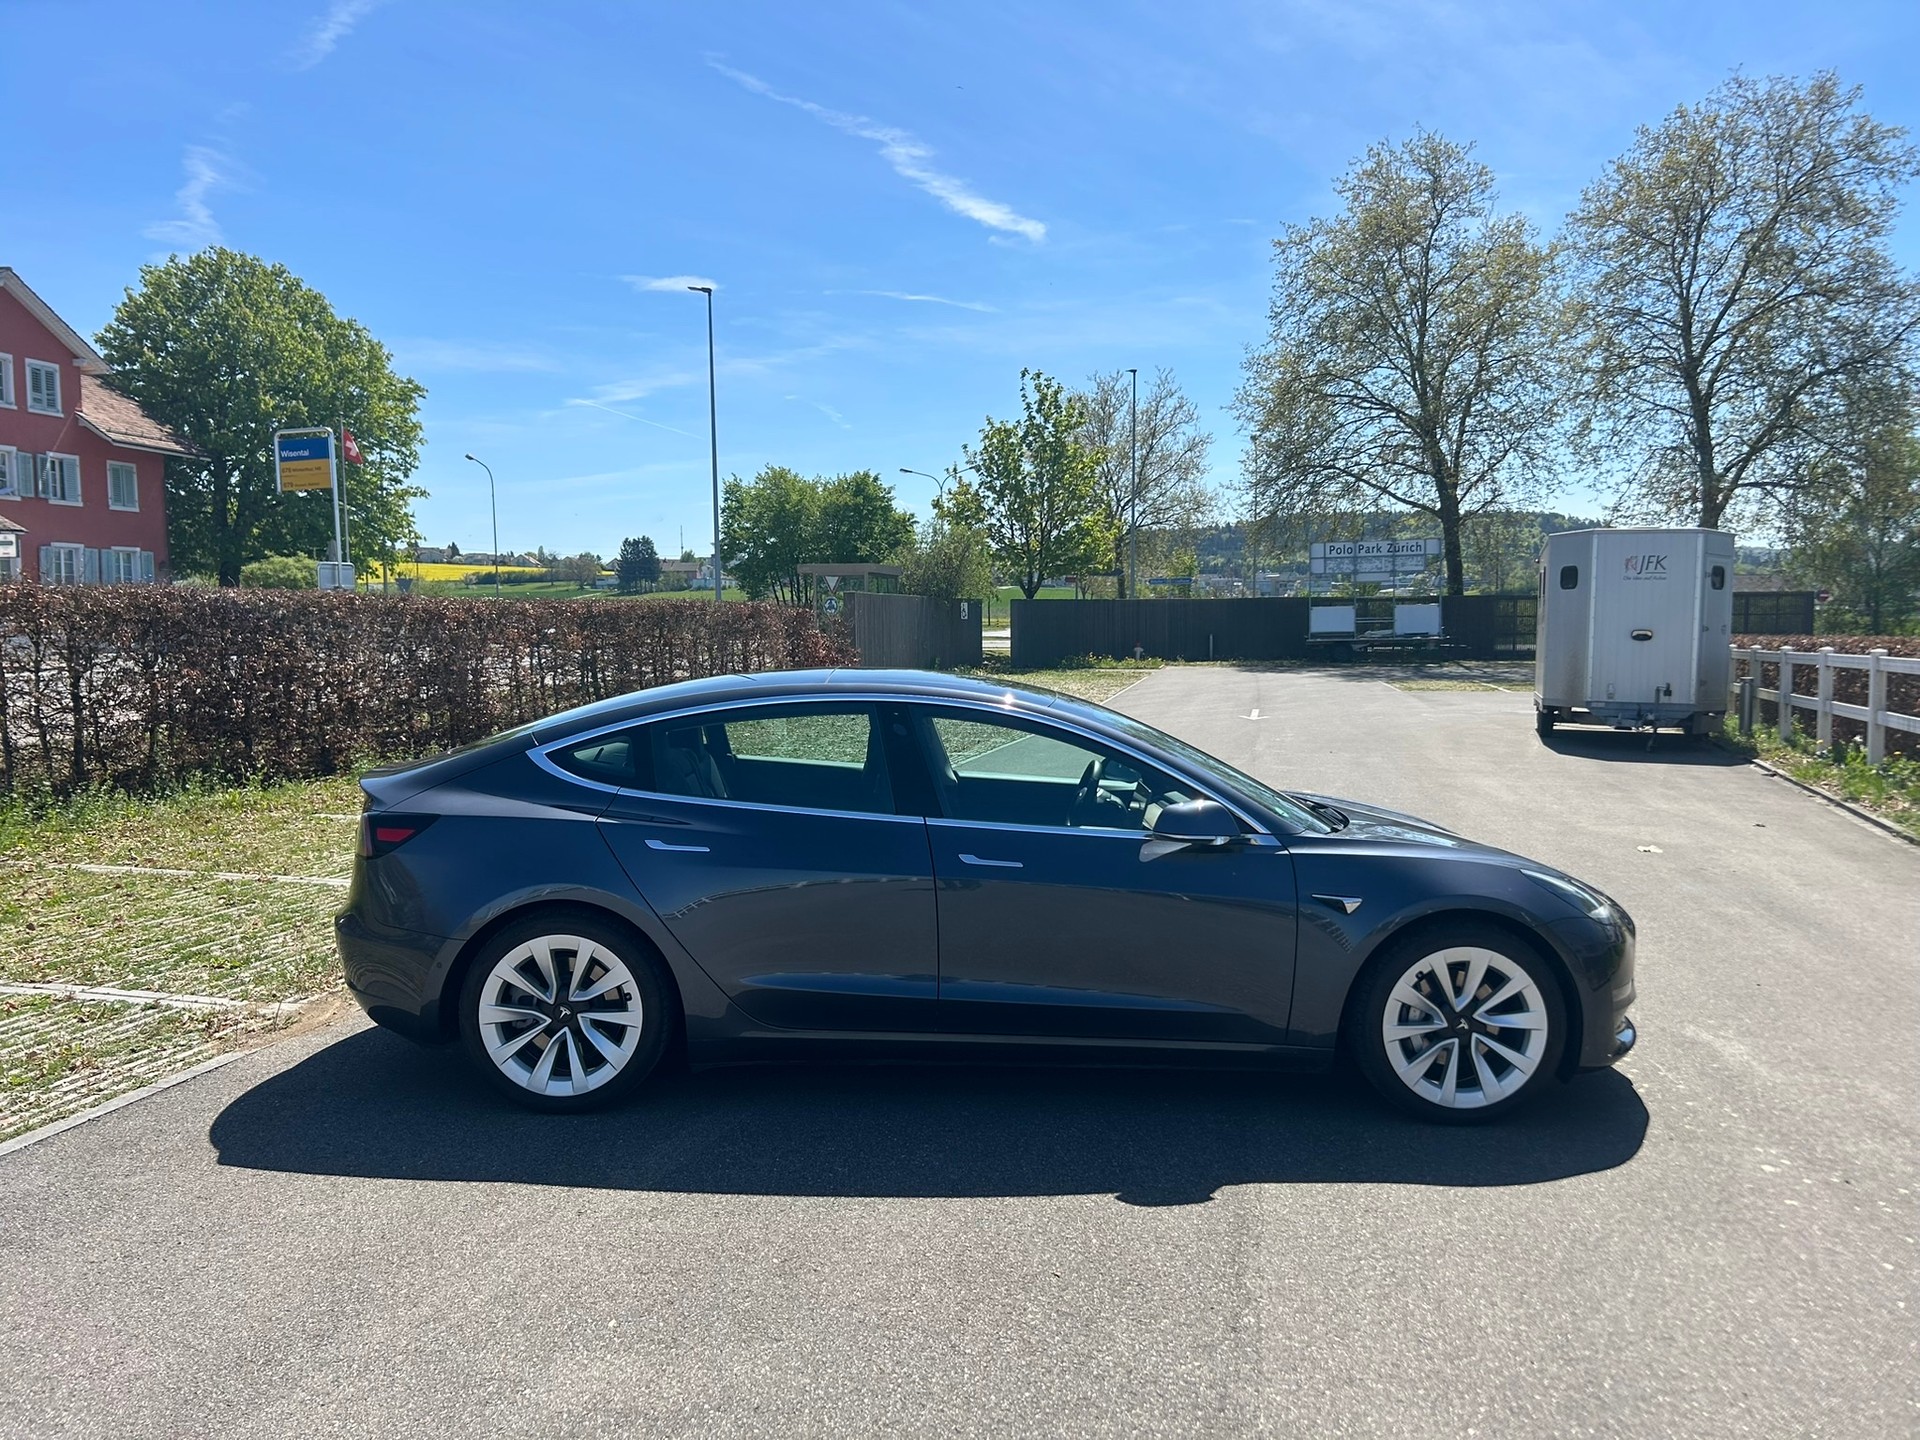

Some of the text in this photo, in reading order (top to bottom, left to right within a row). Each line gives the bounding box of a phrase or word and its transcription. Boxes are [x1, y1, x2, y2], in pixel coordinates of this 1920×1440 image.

[280, 449, 309, 458] Wisental
[1329, 541, 1422, 555] Polo Park Zürich
[1637, 555, 1667, 575] JFK
